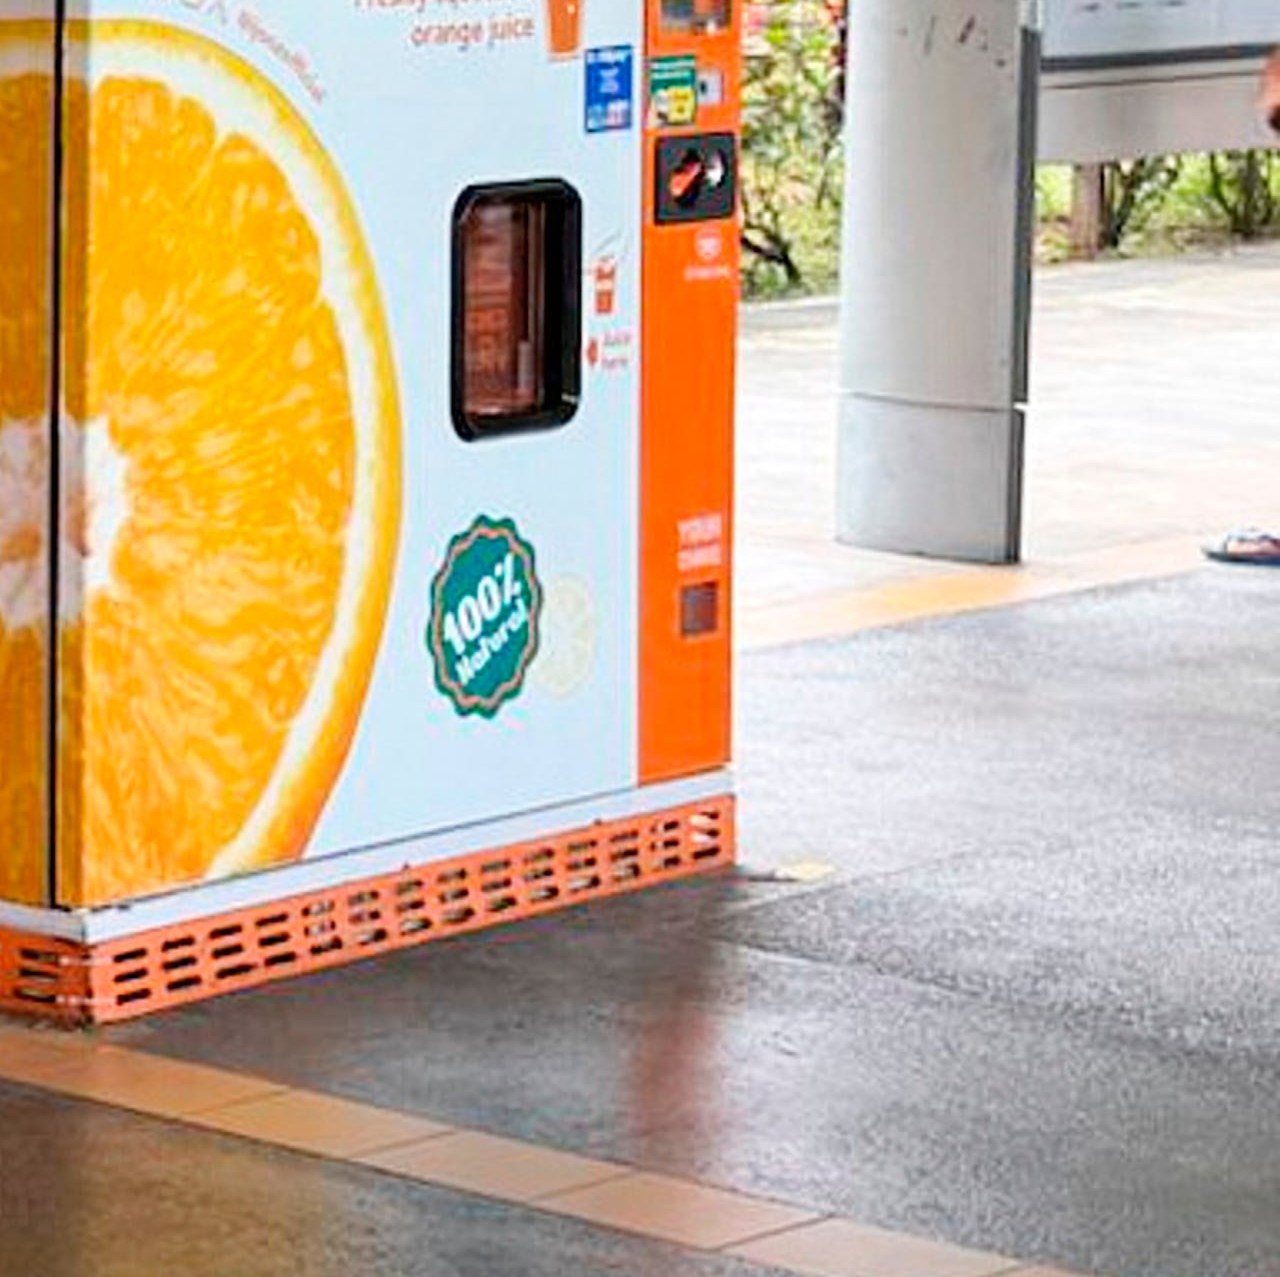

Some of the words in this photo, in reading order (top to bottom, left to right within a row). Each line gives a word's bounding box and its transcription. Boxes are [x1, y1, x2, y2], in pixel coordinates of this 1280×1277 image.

[411, 21, 483, 53] orange
[488, 17, 534, 49] juice
[443, 553, 522, 655] 100%
[454, 592, 529, 688] Natural
